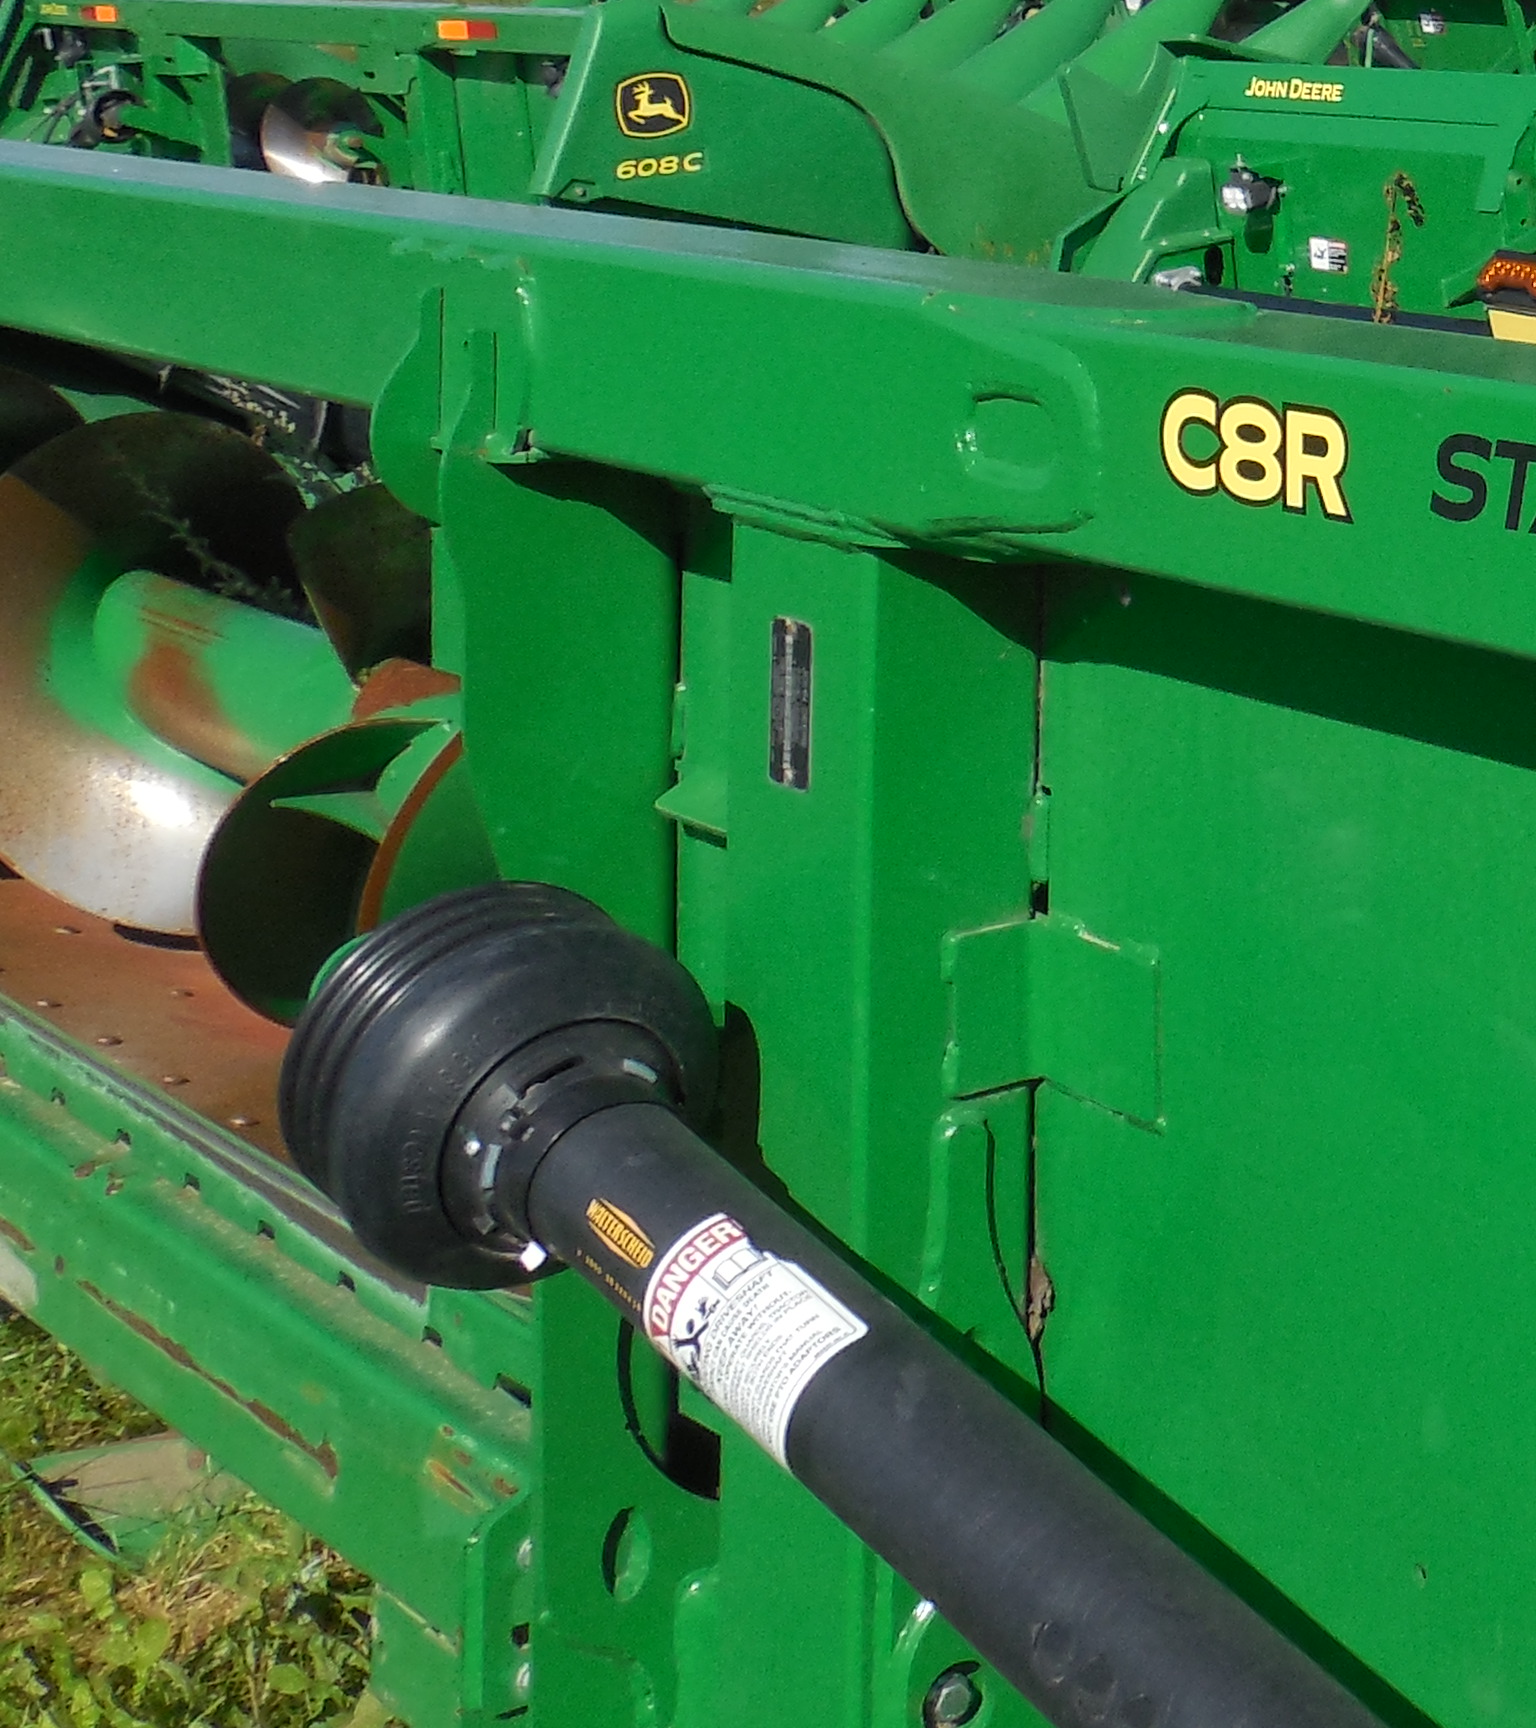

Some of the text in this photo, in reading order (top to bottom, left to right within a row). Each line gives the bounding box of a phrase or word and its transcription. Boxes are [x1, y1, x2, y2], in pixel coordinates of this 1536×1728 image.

[1245, 76, 1344, 102] JOHN DEERE
[616, 152, 703, 180] 608C
[1160, 388, 1353, 523] C8R
[586, 1198, 654, 1268] WALTERSCHEID
[652, 1221, 743, 1332] DANGER
